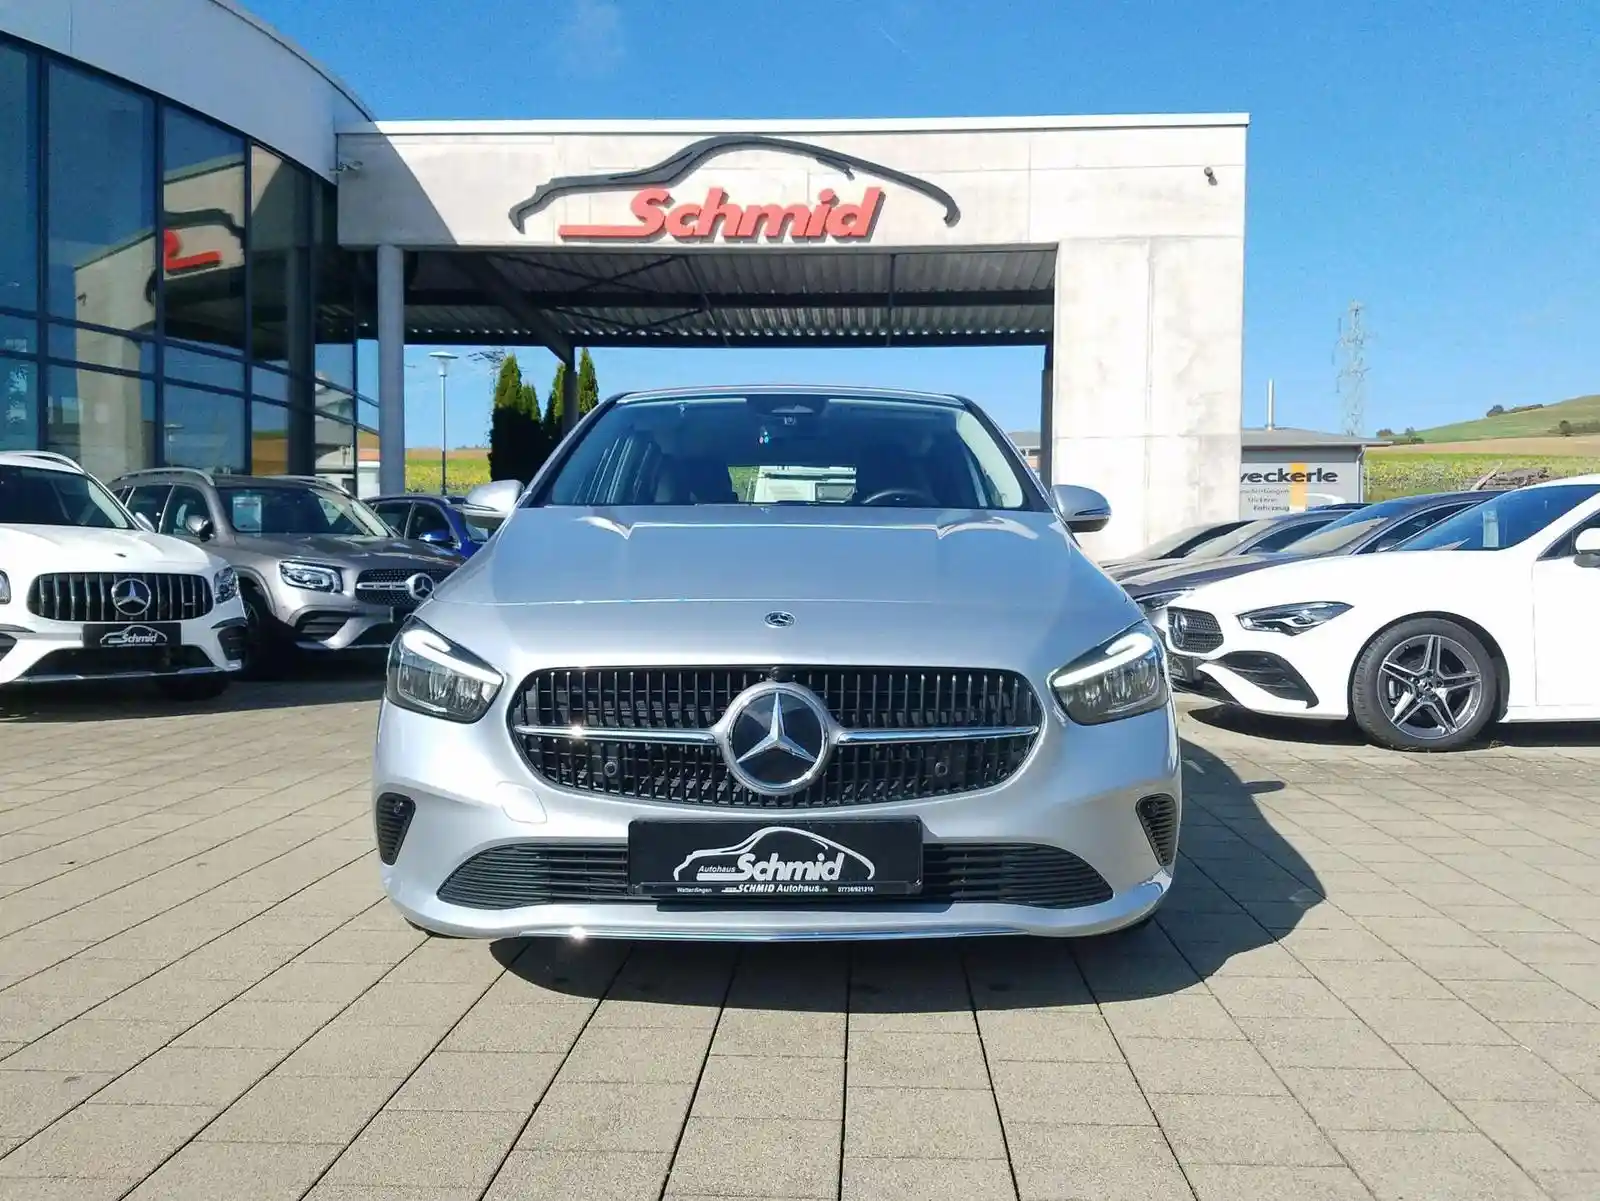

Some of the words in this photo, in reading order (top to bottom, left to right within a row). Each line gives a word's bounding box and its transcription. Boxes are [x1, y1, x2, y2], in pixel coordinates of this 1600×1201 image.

[559, 186, 884, 242] Schmid
[697, 853, 844, 880] Schmid
[699, 865, 736, 873] Autohaus
[738, 884, 774, 893] SCHMID
